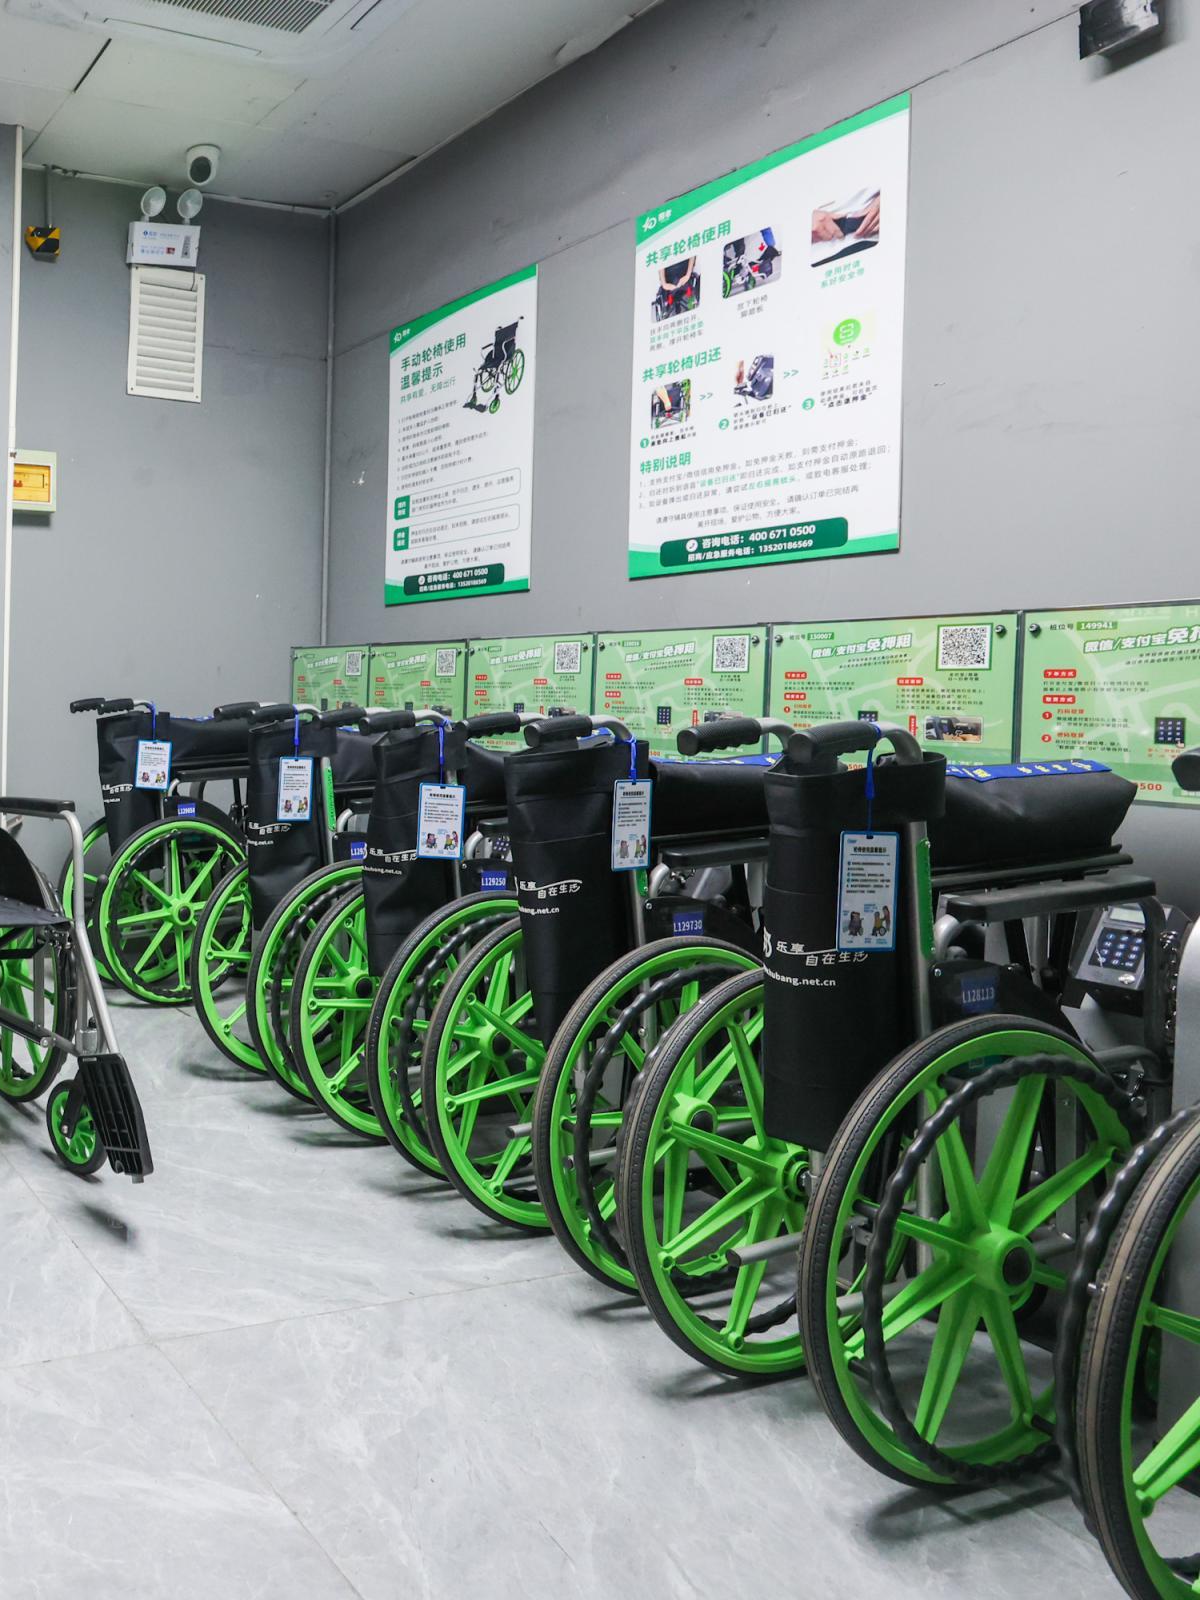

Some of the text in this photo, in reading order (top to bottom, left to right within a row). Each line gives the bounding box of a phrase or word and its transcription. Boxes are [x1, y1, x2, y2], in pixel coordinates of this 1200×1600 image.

[645, 220, 731, 268] 共享轮椅使用
[401, 333, 466, 371] 手动轮椅使用
[642, 347, 721, 382] 共享轮椅归还
[400, 362, 443, 390] 温馨提示
[640, 451, 692, 475] 特别说明
[748, 530, 767, 542] 400
[768, 528, 788, 540] 671
[789, 524, 816, 537] 0500
[453, 571, 462, 579] 400
[474, 568, 488, 576] 0500
[1080, 621, 1113, 630] 149941
[538, 884, 581, 899] 自在生活
[776, 941, 805, 954] 乐享
[805, 951, 869, 967] 自在生活
